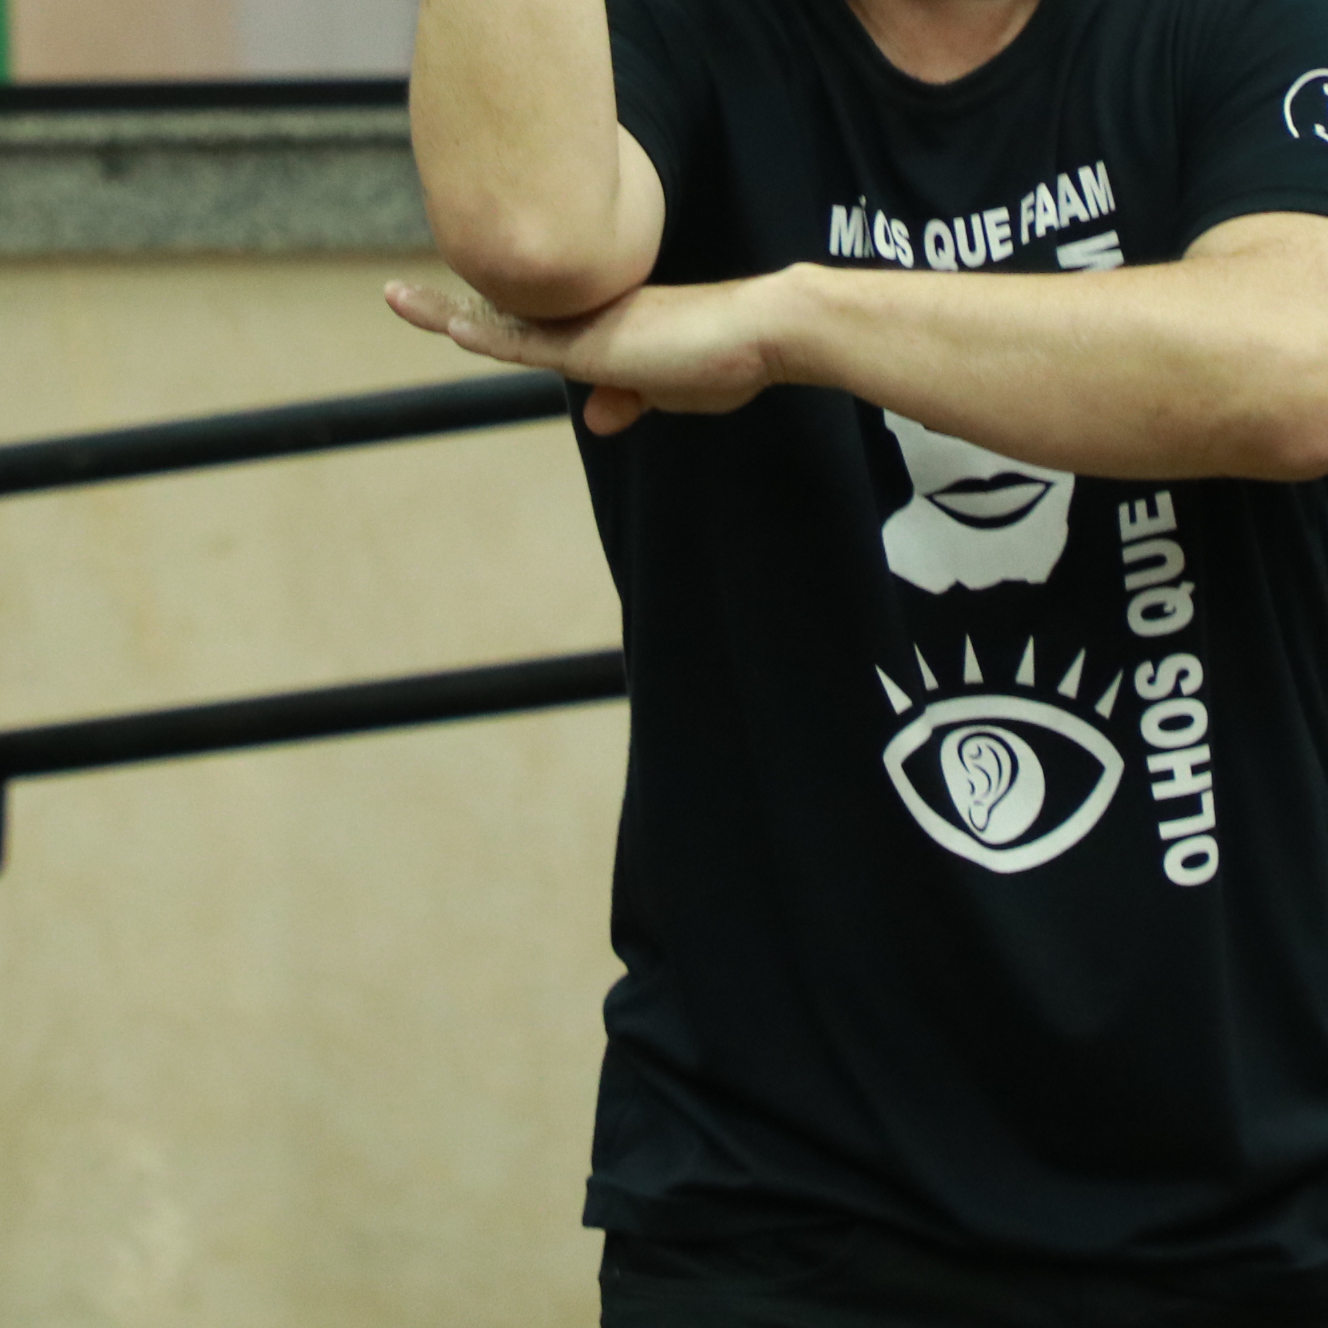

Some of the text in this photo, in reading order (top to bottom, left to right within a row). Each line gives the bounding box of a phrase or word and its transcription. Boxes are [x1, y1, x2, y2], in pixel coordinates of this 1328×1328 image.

[924, 206, 1014, 272] QUE
[1118, 490, 1220, 887] OLHOS QUE
